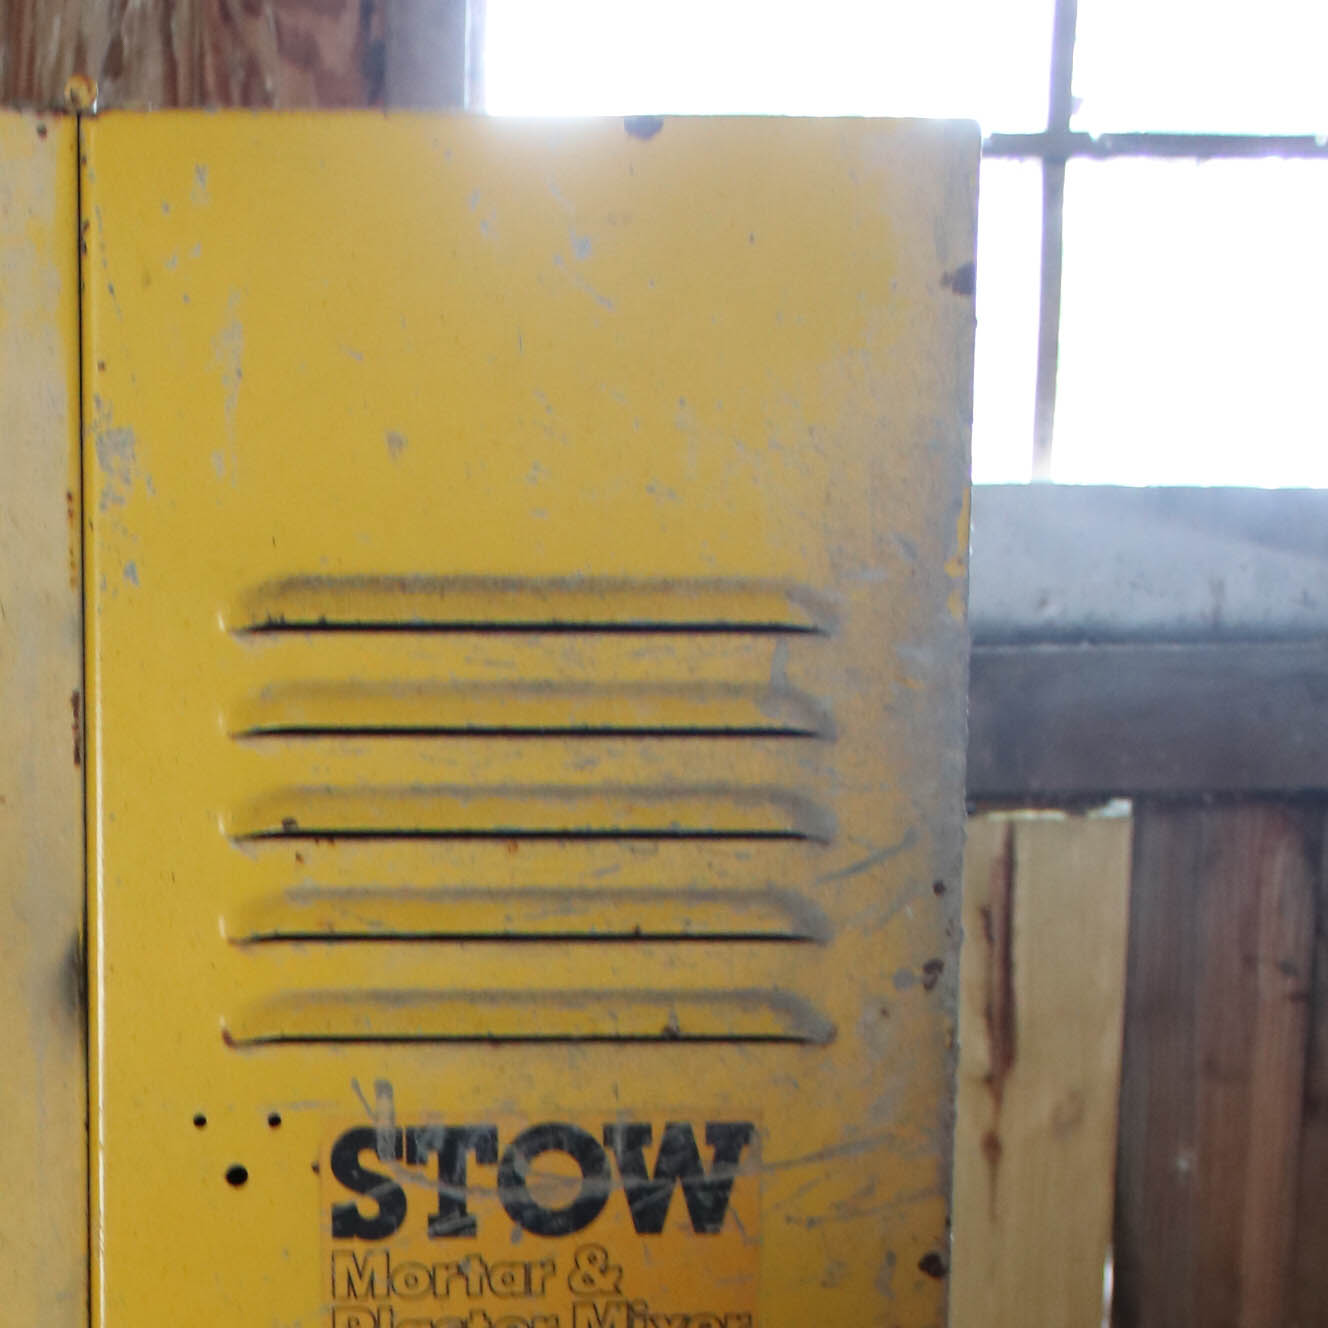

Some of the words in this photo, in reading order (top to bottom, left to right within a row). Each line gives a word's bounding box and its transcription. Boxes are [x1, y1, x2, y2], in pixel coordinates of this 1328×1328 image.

[330, 1121, 756, 1240] STOW
[331, 1249, 556, 1300] Mortar
[568, 1243, 623, 1297] &
